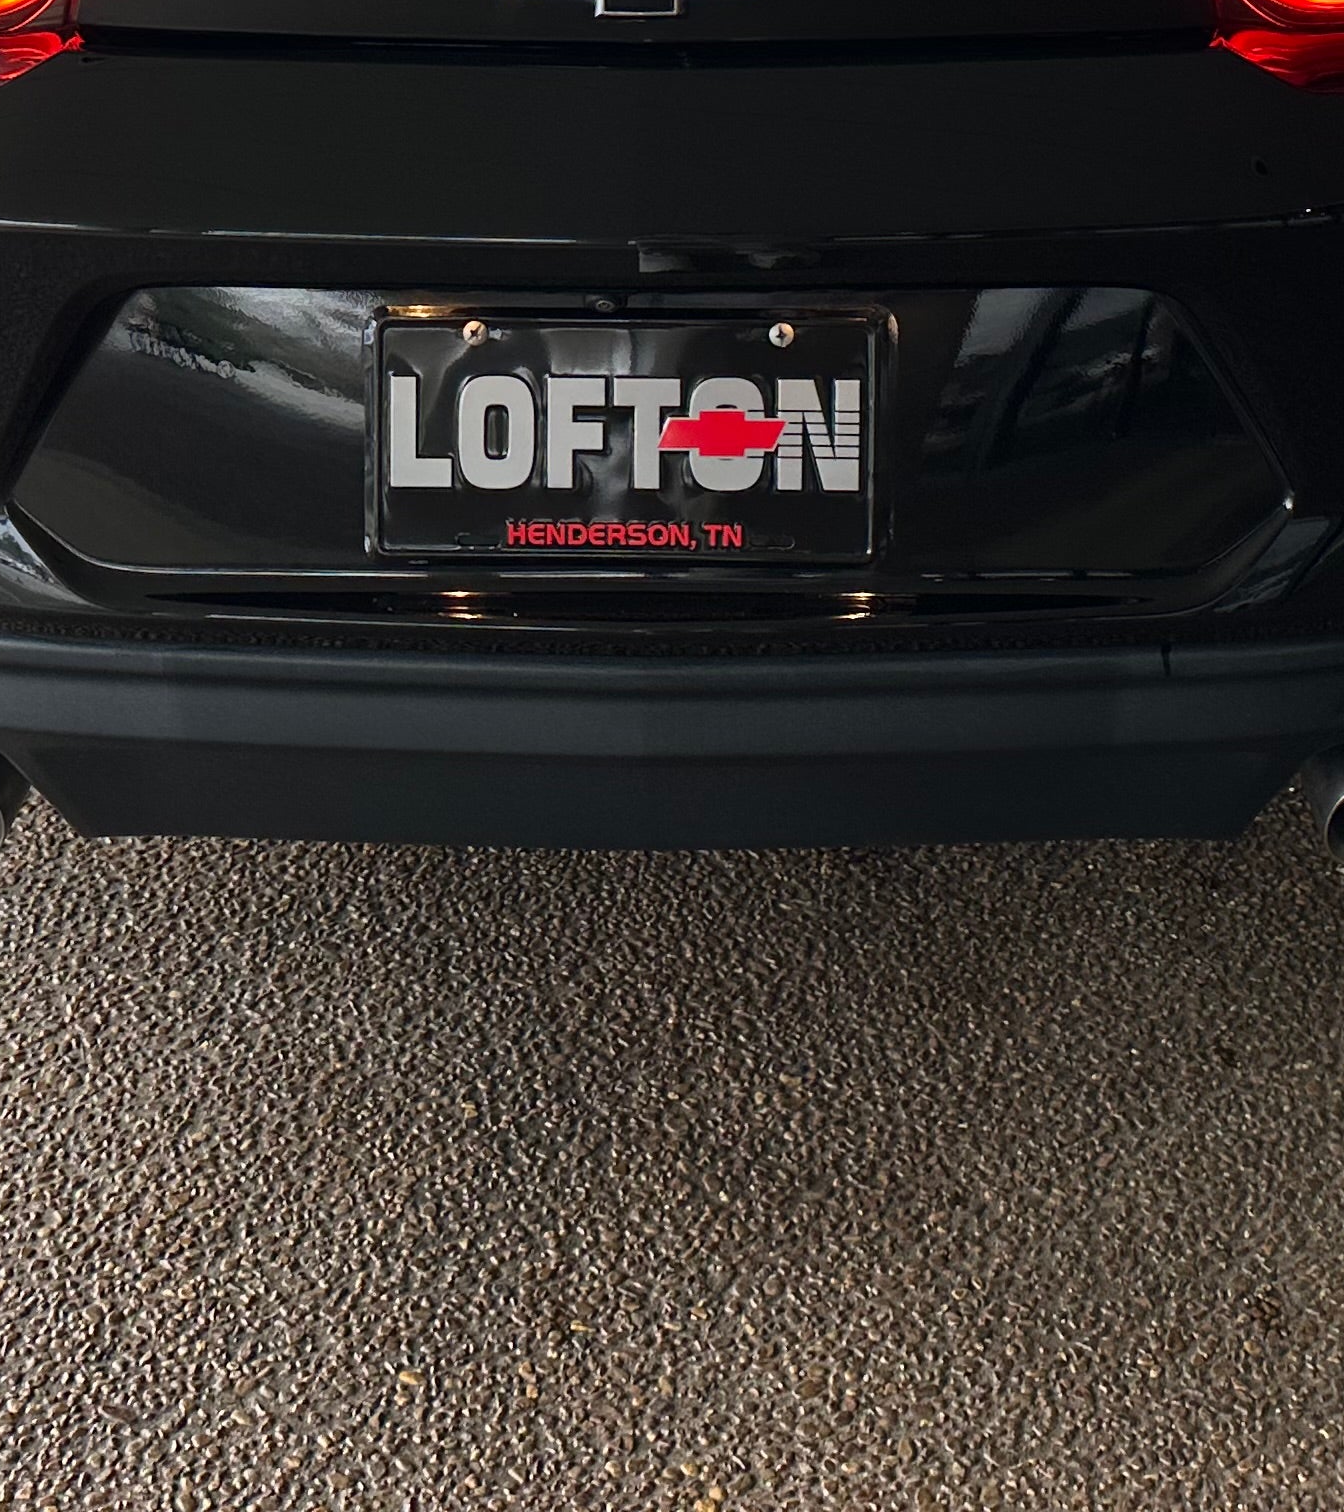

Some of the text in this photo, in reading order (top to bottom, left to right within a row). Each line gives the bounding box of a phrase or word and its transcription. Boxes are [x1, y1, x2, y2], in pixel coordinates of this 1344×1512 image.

[389, 374, 860, 492] LOFTON
[506, 519, 743, 550] HENDERSON, TN
